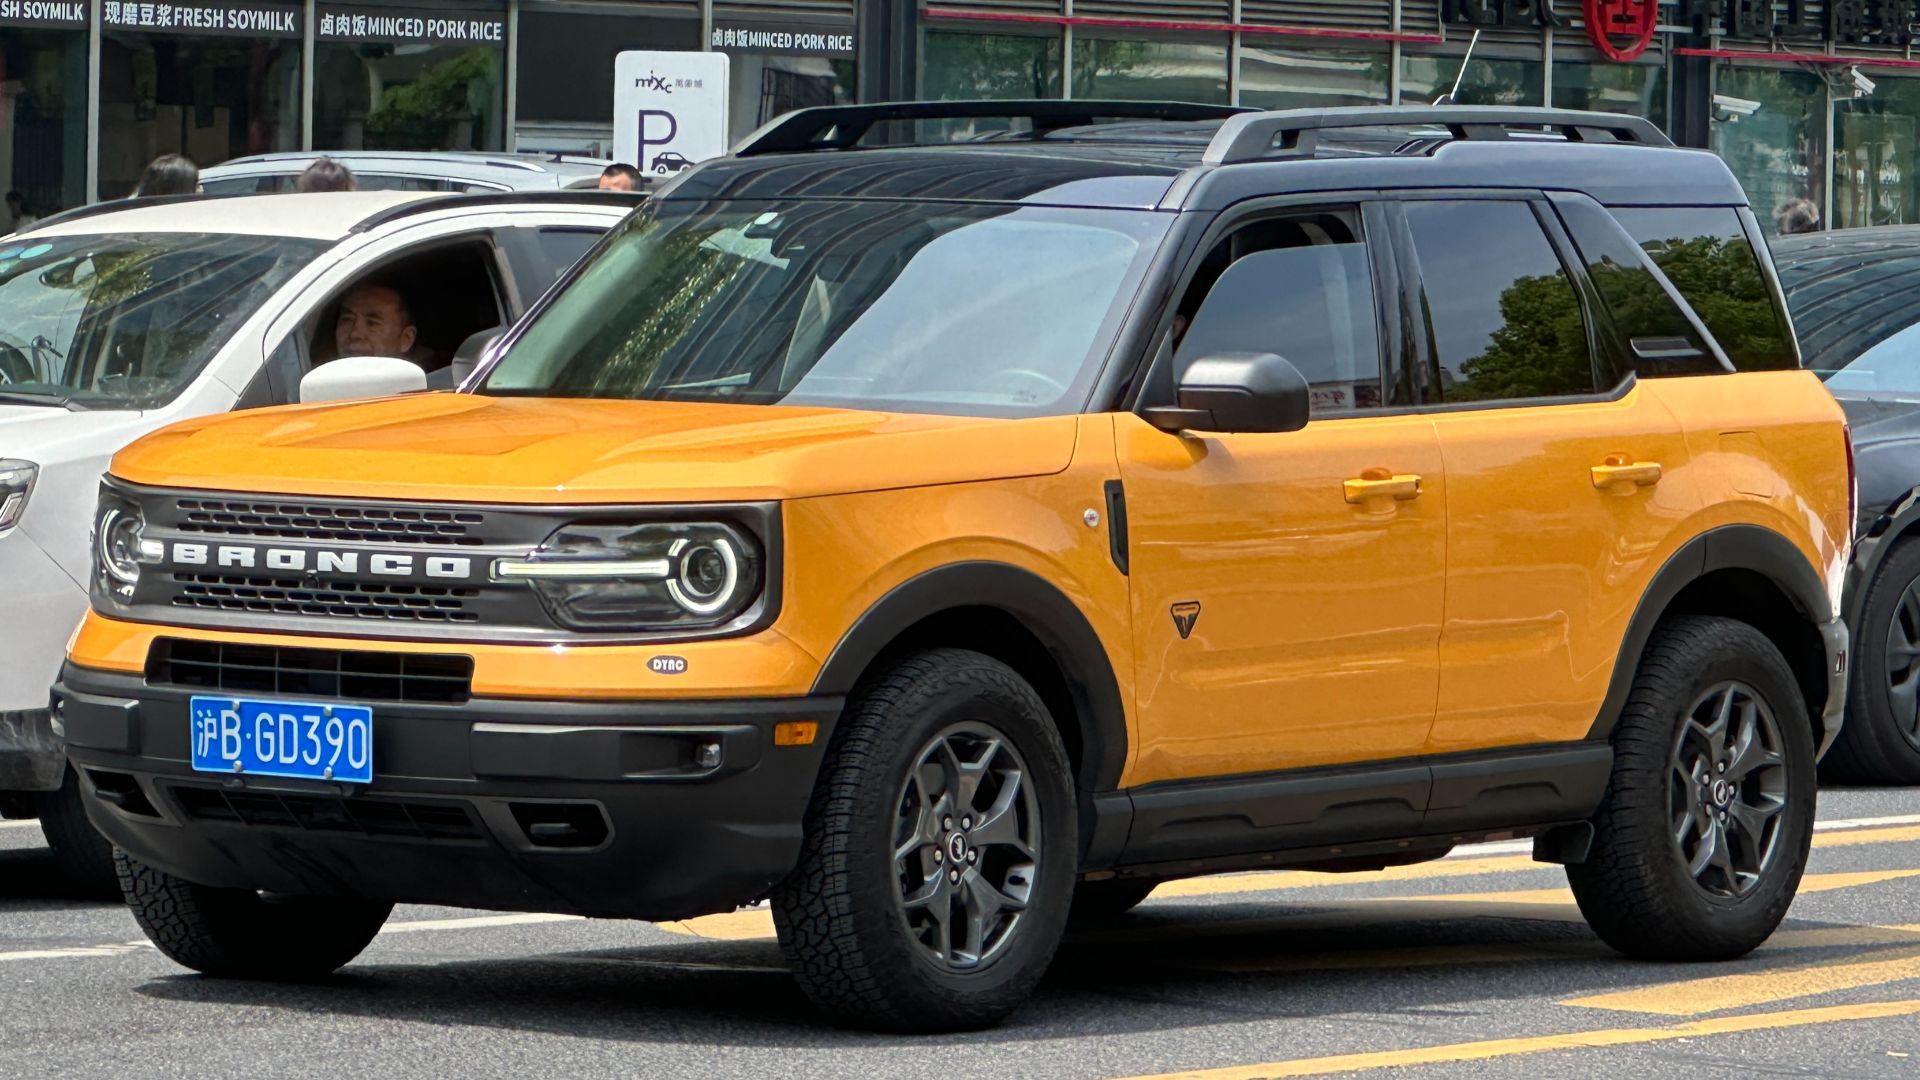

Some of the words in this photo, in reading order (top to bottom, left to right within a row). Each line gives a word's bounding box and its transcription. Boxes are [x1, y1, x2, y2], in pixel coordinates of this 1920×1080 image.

[23, 1, 83, 20] SOYMILK
[174, 7, 223, 28] FRESH
[227, 9, 295, 32] SOYMILK
[368, 17, 423, 37] MINCED
[427, 19, 467, 39] PORK
[470, 21, 502, 40] RICE
[794, 33, 826, 50] PORK
[828, 35, 853, 50] RICE
[637, 109, 677, 172] P
[172, 543, 471, 578] BRONCO
